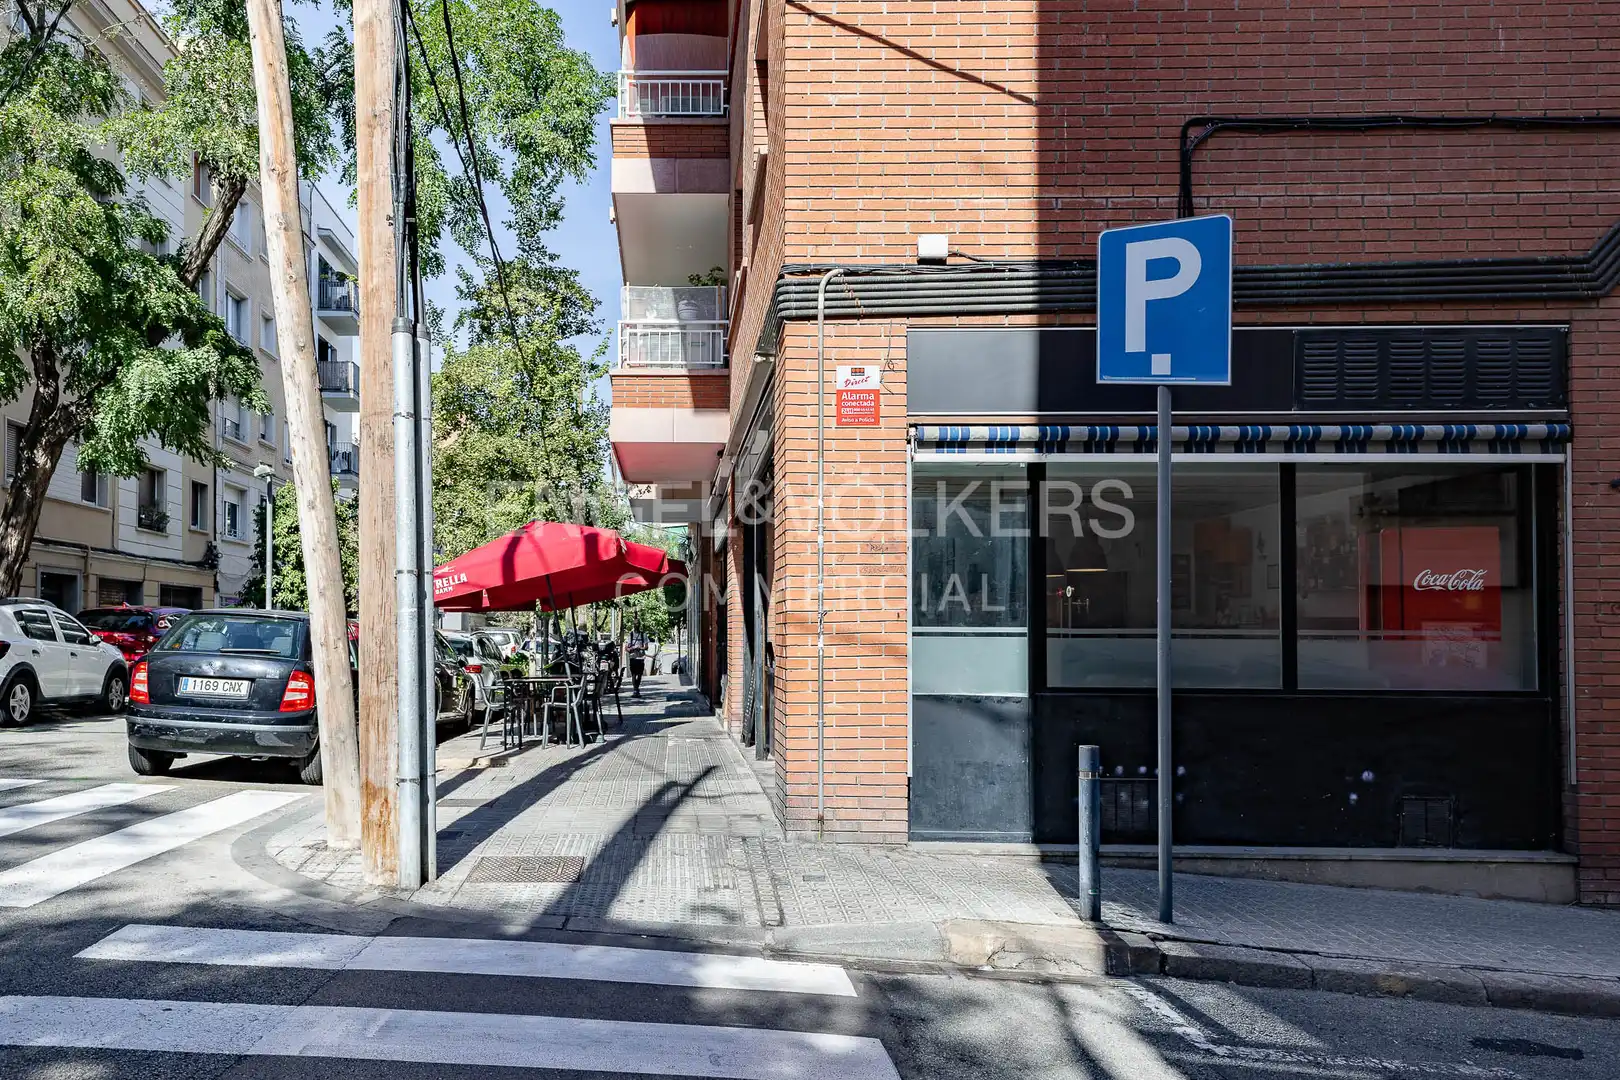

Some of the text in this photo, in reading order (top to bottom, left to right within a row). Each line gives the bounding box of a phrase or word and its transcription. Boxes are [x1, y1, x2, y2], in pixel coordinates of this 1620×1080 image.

[1125, 237, 1202, 352] P
[841, 392, 874, 400] Alarma
[433, 573, 468, 589] RELLA
[1413, 569, 1487, 591] Coca-Cola
[192, 679, 244, 693] 1169 CNX
